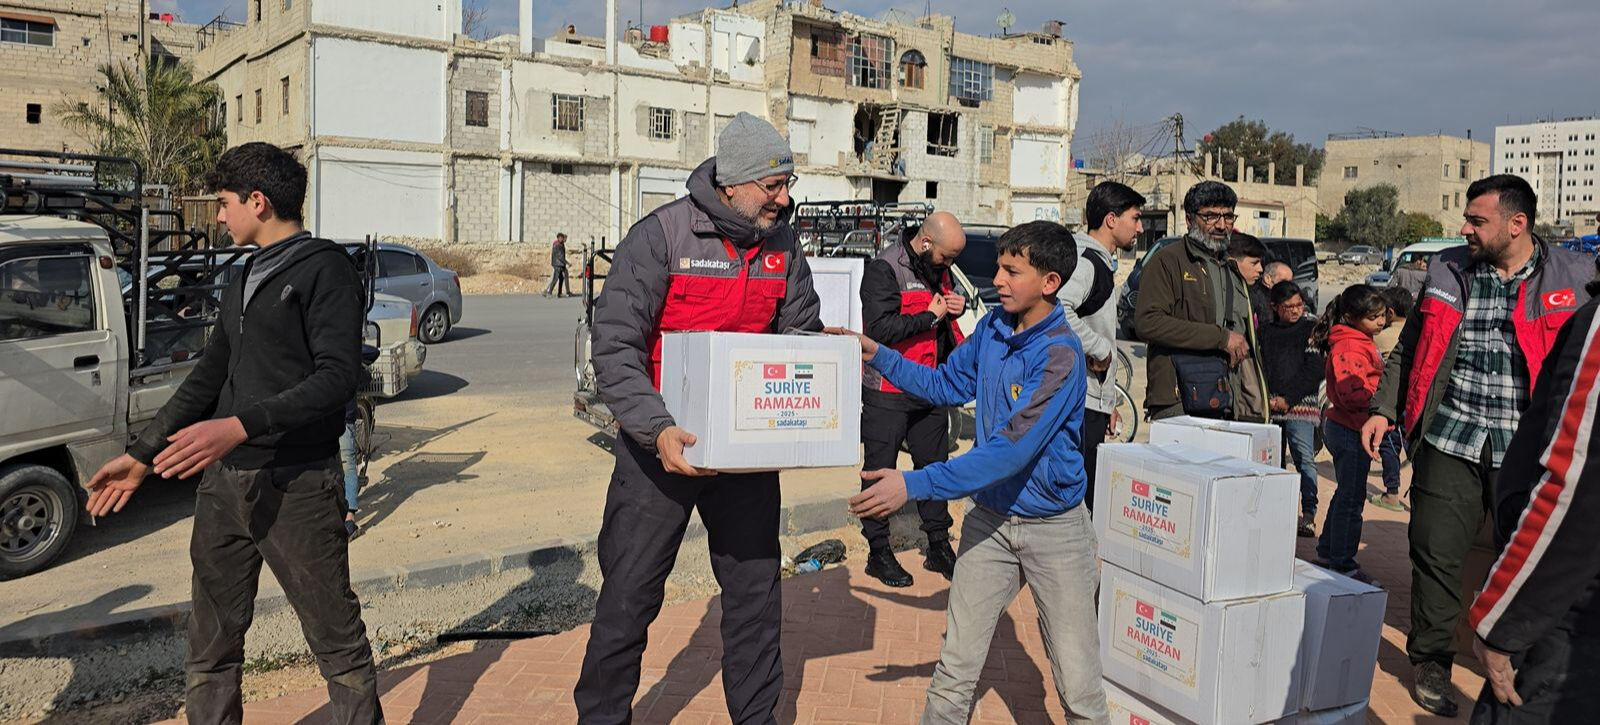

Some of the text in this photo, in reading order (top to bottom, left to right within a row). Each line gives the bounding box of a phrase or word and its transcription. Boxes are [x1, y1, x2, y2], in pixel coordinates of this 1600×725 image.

[691, 259, 730, 270] sadakataşı
[765, 379, 811, 394] SURİYE
[754, 396, 821, 410] RAMAZAN
[776, 419, 808, 428] sadakataşı
[1131, 495, 1168, 517] SURİYE
[1123, 505, 1176, 534] RAMAZAN
[1135, 616, 1173, 643] SURİYE
[1127, 625, 1181, 661] RAMAZAN
